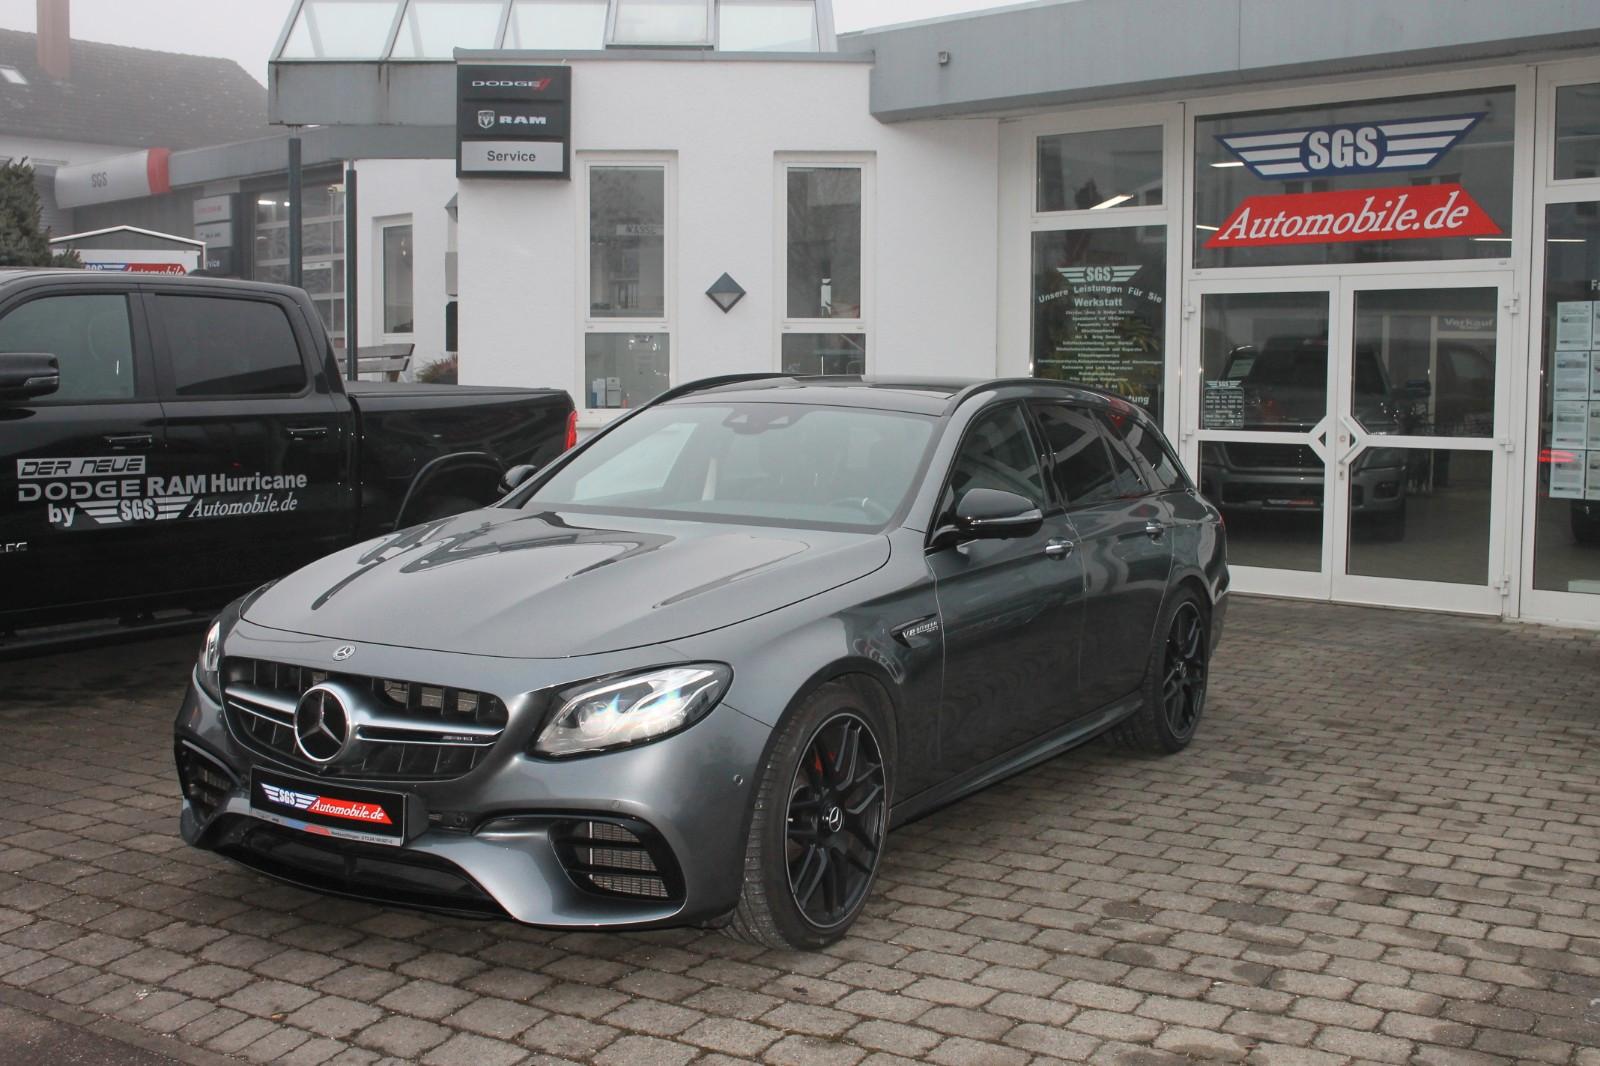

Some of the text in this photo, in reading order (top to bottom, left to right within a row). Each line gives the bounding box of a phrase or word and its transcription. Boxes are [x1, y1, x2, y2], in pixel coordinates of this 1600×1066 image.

[499, 115, 547, 125] RAM
[487, 150, 536, 162] Service
[1307, 126, 1379, 170] SGS
[91, 172, 108, 189] SGS
[1218, 190, 1469, 241] Automobile.de
[1086, 266, 1111, 282] SGS
[1038, 285, 1162, 304] Unsere Leistungen Für Sie
[1074, 298, 1123, 307] Werkstatt
[21, 460, 71, 476] DER
[18, 471, 308, 502] DODGE RAM Hurricane
[48, 492, 298, 527] by SGS Automobile.de
[279, 789, 385, 821] SGS Automobile.de
